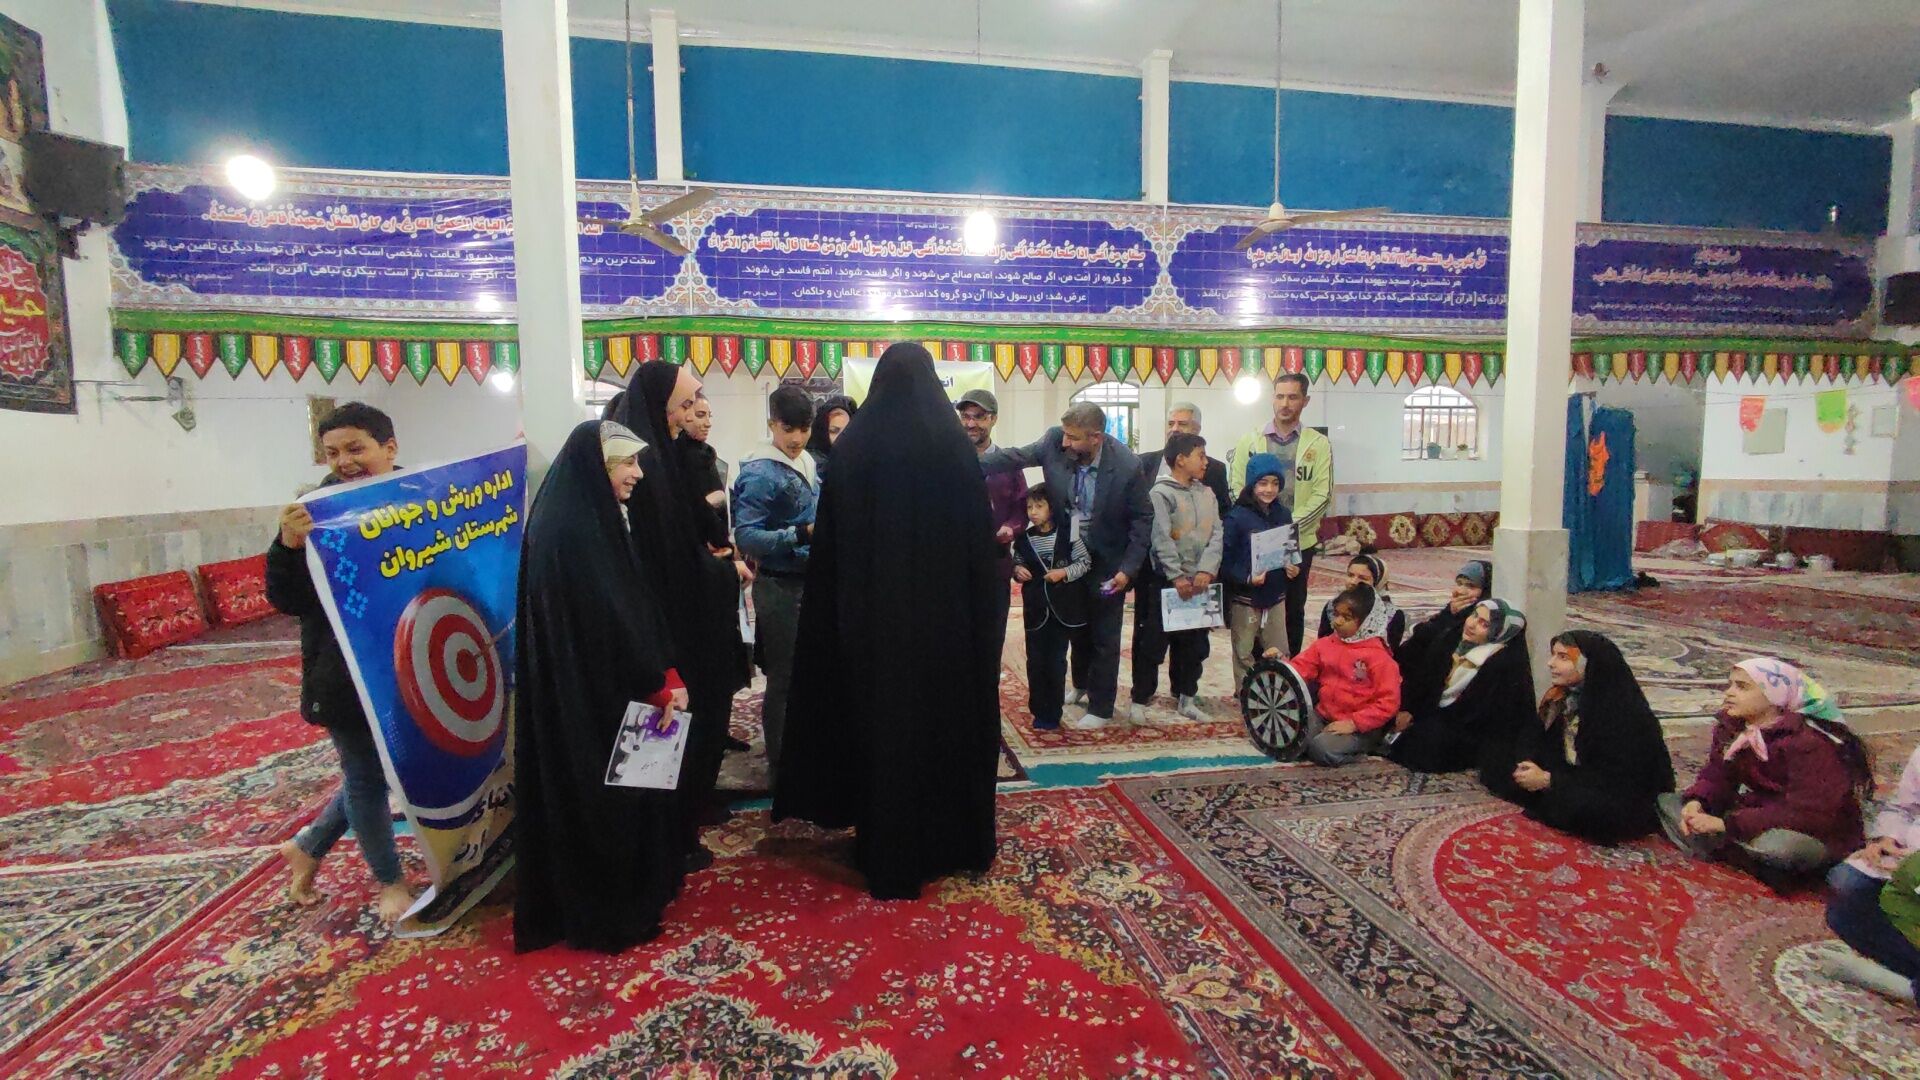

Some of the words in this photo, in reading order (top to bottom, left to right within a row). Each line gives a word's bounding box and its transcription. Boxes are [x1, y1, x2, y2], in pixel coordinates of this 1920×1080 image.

[143, 239, 168, 251] شود
[168, 242, 186, 252] می
[217, 239, 253, 254] دیگری
[254, 242, 284, 256] توسط
[307, 244, 342, 258] زندگی
[344, 246, 358, 256] که
[285, 247, 305, 257] اش
[358, 247, 384, 257] است
[386, 248, 423, 260] شخصی
[579, 256, 604, 268] مردم
[603, 255, 629, 268] ترین
[629, 256, 656, 267] سخت
[248, 263, 274, 273] است
[276, 262, 308, 276] آفرین
[384, 268, 409, 278] است
[771, 268, 785, 278] می
[786, 265, 811, 276] فاسد
[864, 269, 888, 279] فاسد
[890, 269, 903, 281] اگر
[912, 270, 936, 282] شوند
[937, 272, 950, 282] می
[951, 270, 972, 284] صالح
[1021, 272, 1042, 286] صالح
[1043, 272, 1056, 284] اگر
[1092, 273, 1101, 285] از
[1101, 274, 1121, 285] گروه
[1121, 276, 1133, 286] دو
[1270, 274, 1287, 287] کس
[1286, 276, 1300, 286] سه
[1301, 275, 1330, 287] نشستن
[1330, 274, 1345, 287] مگر
[1345, 276, 1364, 286] است
[1388, 279, 1410, 289] مسجد
[1411, 280, 1420, 289] در
[1452, 281, 1462, 290] هر
[826, 290, 832, 300] و
[940, 289, 961, 303] گروه
[961, 291, 973, 303] دو
[973, 288, 986, 303] آن
[1006, 292, 1032, 304] رسول
[1033, 292, 1044, 304] ای
[1064, 293, 1087, 304] عرض
[1290, 293, 1299, 302] به
[1299, 290, 1310, 300] که
[1310, 291, 1329, 302] کسی
[1358, 291, 1373, 302] خدا
[1387, 292, 1397, 303] که
[1397, 292, 1415, 304] کسی
[483, 469, 514, 500] اداره
[441, 483, 483, 517] ورزش
[426, 499, 438, 521] و
[359, 502, 423, 541] جوانان
[454, 504, 518, 550] شهرستان
[380, 529, 452, 579] شیروان
